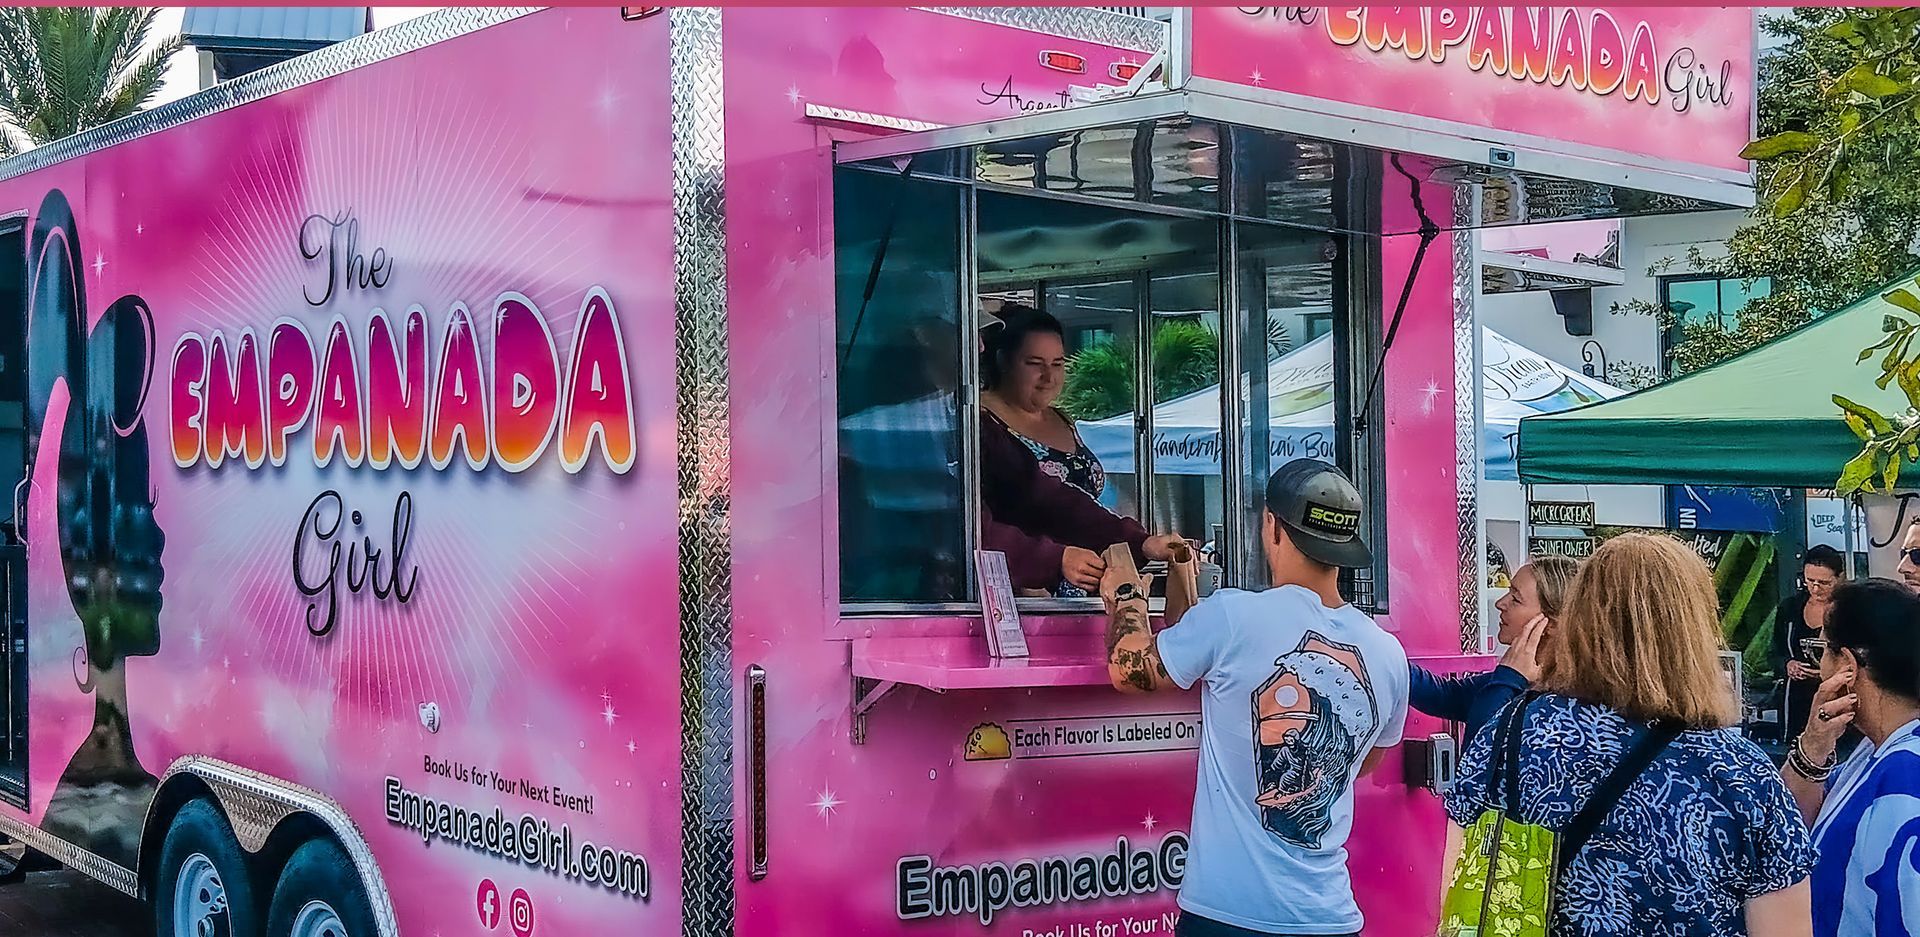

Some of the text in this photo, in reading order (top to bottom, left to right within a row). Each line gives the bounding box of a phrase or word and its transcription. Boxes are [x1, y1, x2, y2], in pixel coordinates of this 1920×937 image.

[1324, 7, 1660, 105] EMPANADA
[1664, 47, 1733, 112] Girl
[300, 206, 393, 306] The
[169, 285, 637, 475] EMPANADA
[293, 490, 418, 637] Girl
[1310, 507, 1357, 525] SCOTT
[1538, 540, 1590, 557] SUNFLOWER
[1015, 728, 1050, 747] Each
[1055, 726, 1100, 746] Flavor
[1103, 725, 1114, 743] Is
[1117, 722, 1171, 742] Labeled
[1175, 721, 1195, 739] On
[424, 755, 594, 815] Book Us for Your Next Event!
[385, 776, 648, 897] EmpanadaGirl.com
[896, 831, 1190, 926] EmpanadaG
[1095, 920, 1118, 937] for
[1121, 917, 1158, 935] Your
[1162, 912, 1180, 933] N
